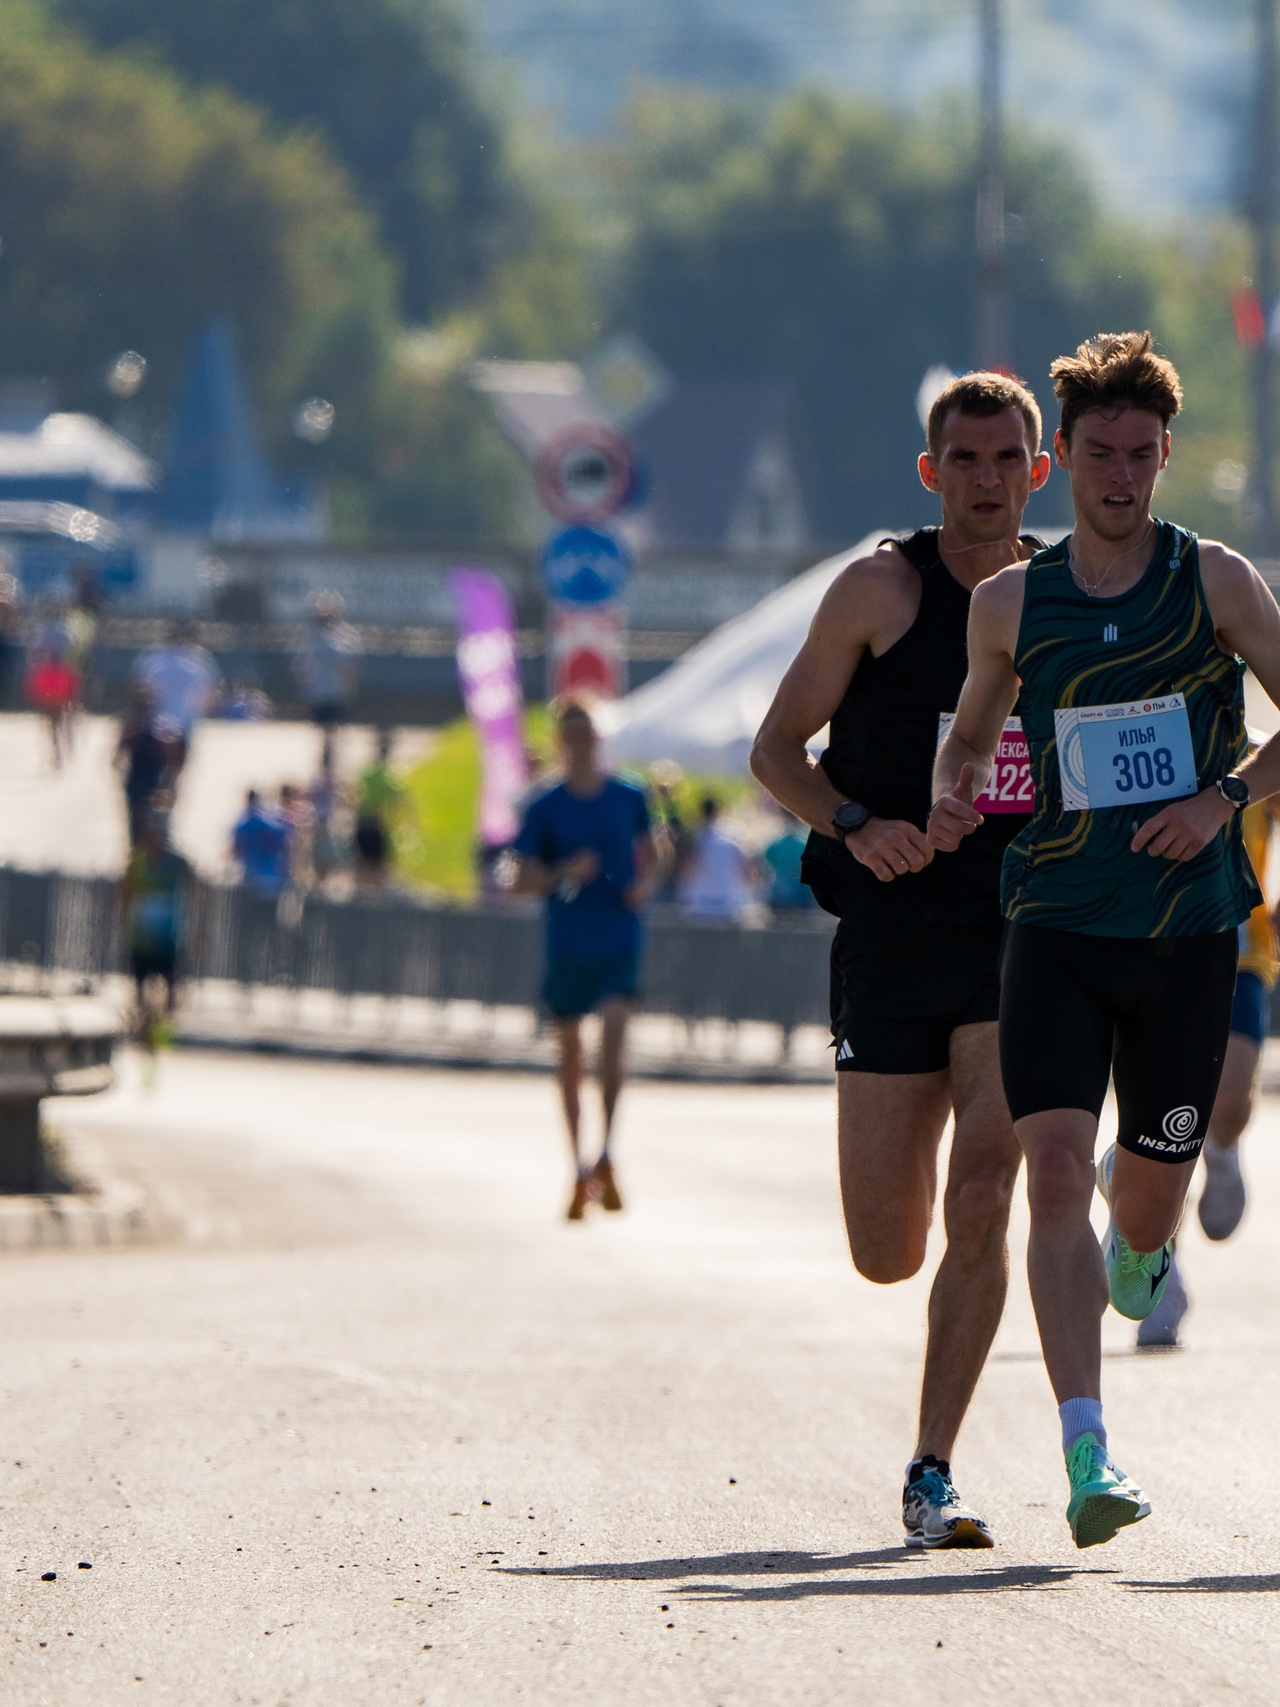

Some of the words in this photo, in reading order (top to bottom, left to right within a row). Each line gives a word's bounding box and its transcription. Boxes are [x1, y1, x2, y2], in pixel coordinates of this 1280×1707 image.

[1152, 701, 1166, 710] Пэй
[1118, 726, 1156, 747] ИЛЬЯ
[1112, 747, 1176, 793] 308
[981, 763, 1036, 801] 422
[1137, 1135, 1204, 1153] INSANITY
